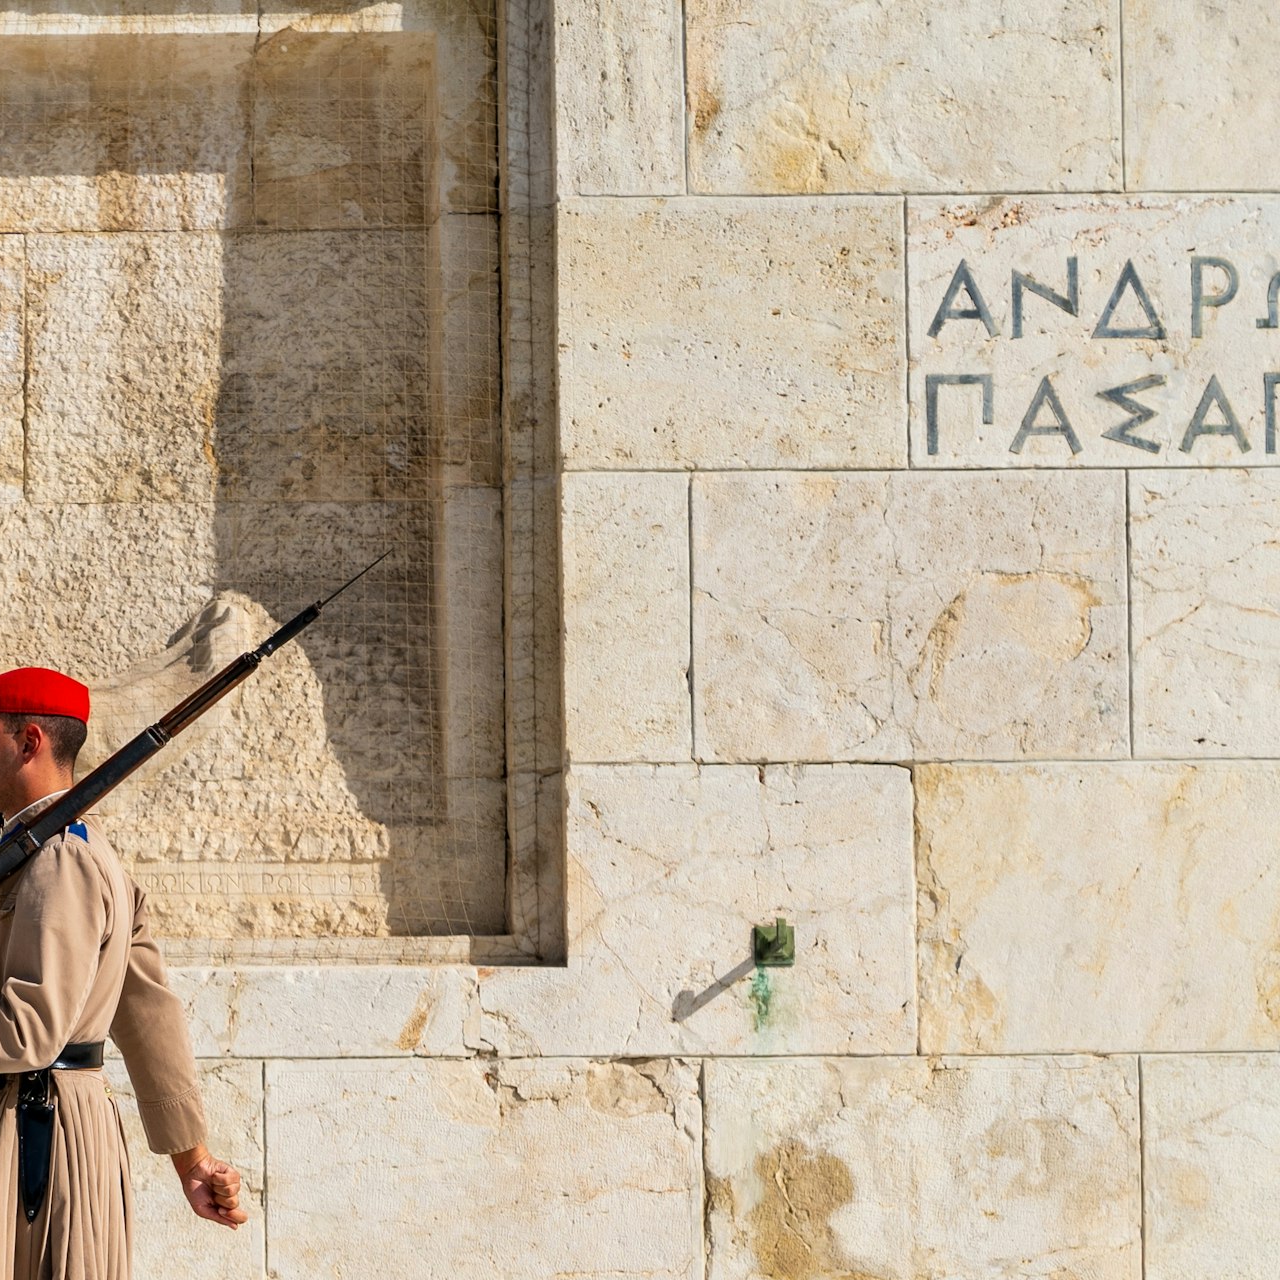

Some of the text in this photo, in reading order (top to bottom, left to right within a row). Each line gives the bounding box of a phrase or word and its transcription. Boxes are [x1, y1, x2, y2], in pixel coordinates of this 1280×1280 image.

[926, 256, 1280, 340] ΑΝΔΡ
[144, 871, 240, 894] ΦΩΚΙΩΝ
[261, 871, 312, 894] ΡΩΚ
